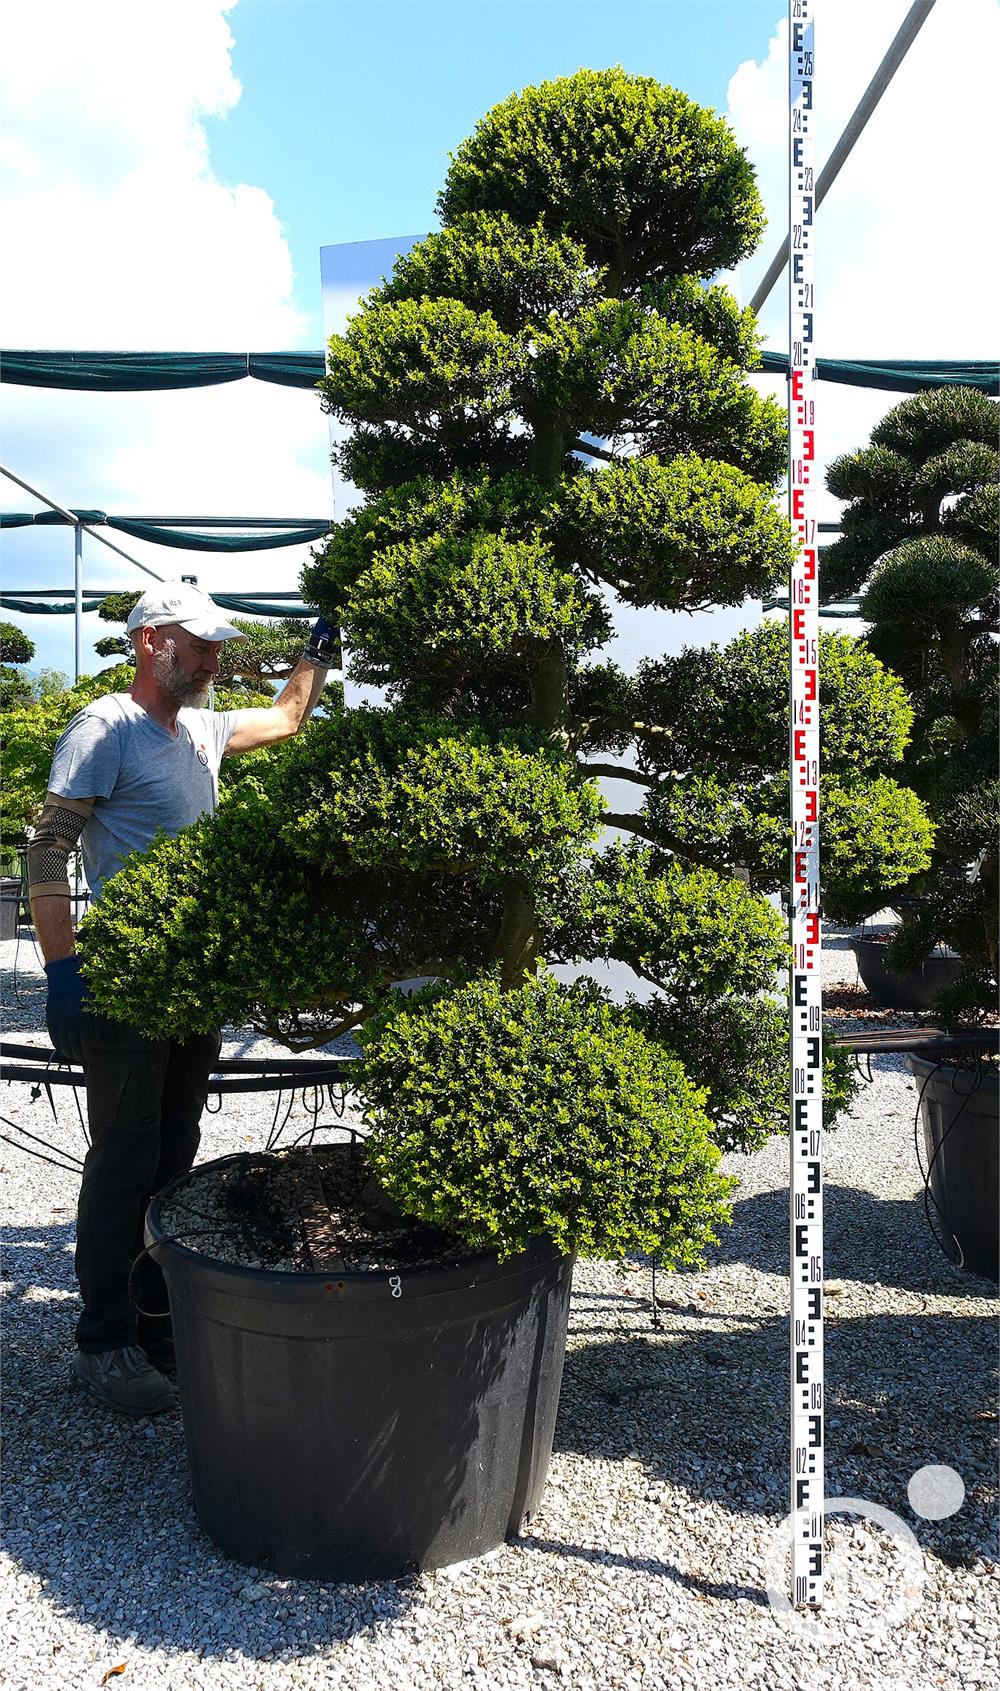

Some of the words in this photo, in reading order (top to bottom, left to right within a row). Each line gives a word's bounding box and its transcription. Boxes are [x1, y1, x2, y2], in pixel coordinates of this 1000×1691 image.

[804, 52, 813, 76] 25
[793, 109, 802, 133] 24
[804, 168, 814, 192] 23
[793, 225, 803, 249] 22
[804, 284, 814, 308] 21
[793, 342, 803, 366] 20
[804, 401, 815, 425] 19
[792, 460, 804, 484] 18
[805, 520, 816, 544] 17
[793, 579, 804, 604] 16
[806, 639, 817, 664] 15
[794, 699, 805, 725] 14
[806, 760, 818, 785] 13
[794, 821, 805, 847] 12
[807, 883, 818, 907] 11
[794, 944, 805, 969] 10
[809, 1006, 820, 1032] 09
[794, 1068, 805, 1094] 08
[809, 1130, 821, 1157] 07
[795, 1193, 806, 1220] 06
[810, 1256, 822, 1283] 05
[388, 1275, 402, 1298] 8
[796, 1319, 807, 1347] 04
[811, 1383, 823, 1410] 03
[796, 1447, 807, 1474] 02
[811, 1511, 823, 1538] 01
[796, 1576, 807, 1604] 00
